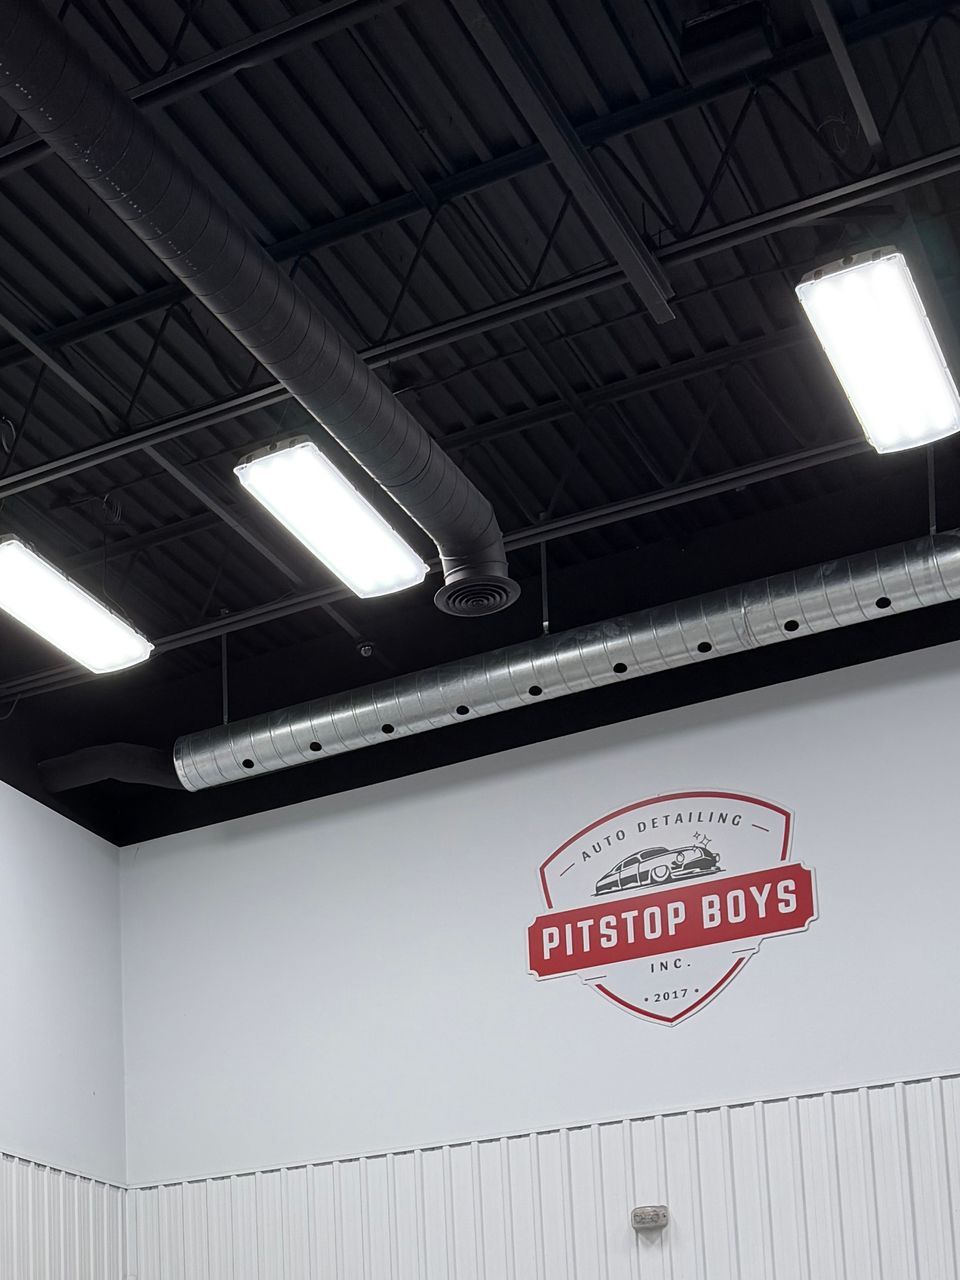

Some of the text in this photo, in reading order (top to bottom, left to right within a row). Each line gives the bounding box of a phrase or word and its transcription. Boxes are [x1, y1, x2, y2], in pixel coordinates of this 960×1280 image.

[581, 811, 742, 862] AUTO DETAILING
[542, 879, 797, 960] PITSTOP BOYS
[650, 958, 692, 973] INC.
[654, 988, 689, 1003] 2017
